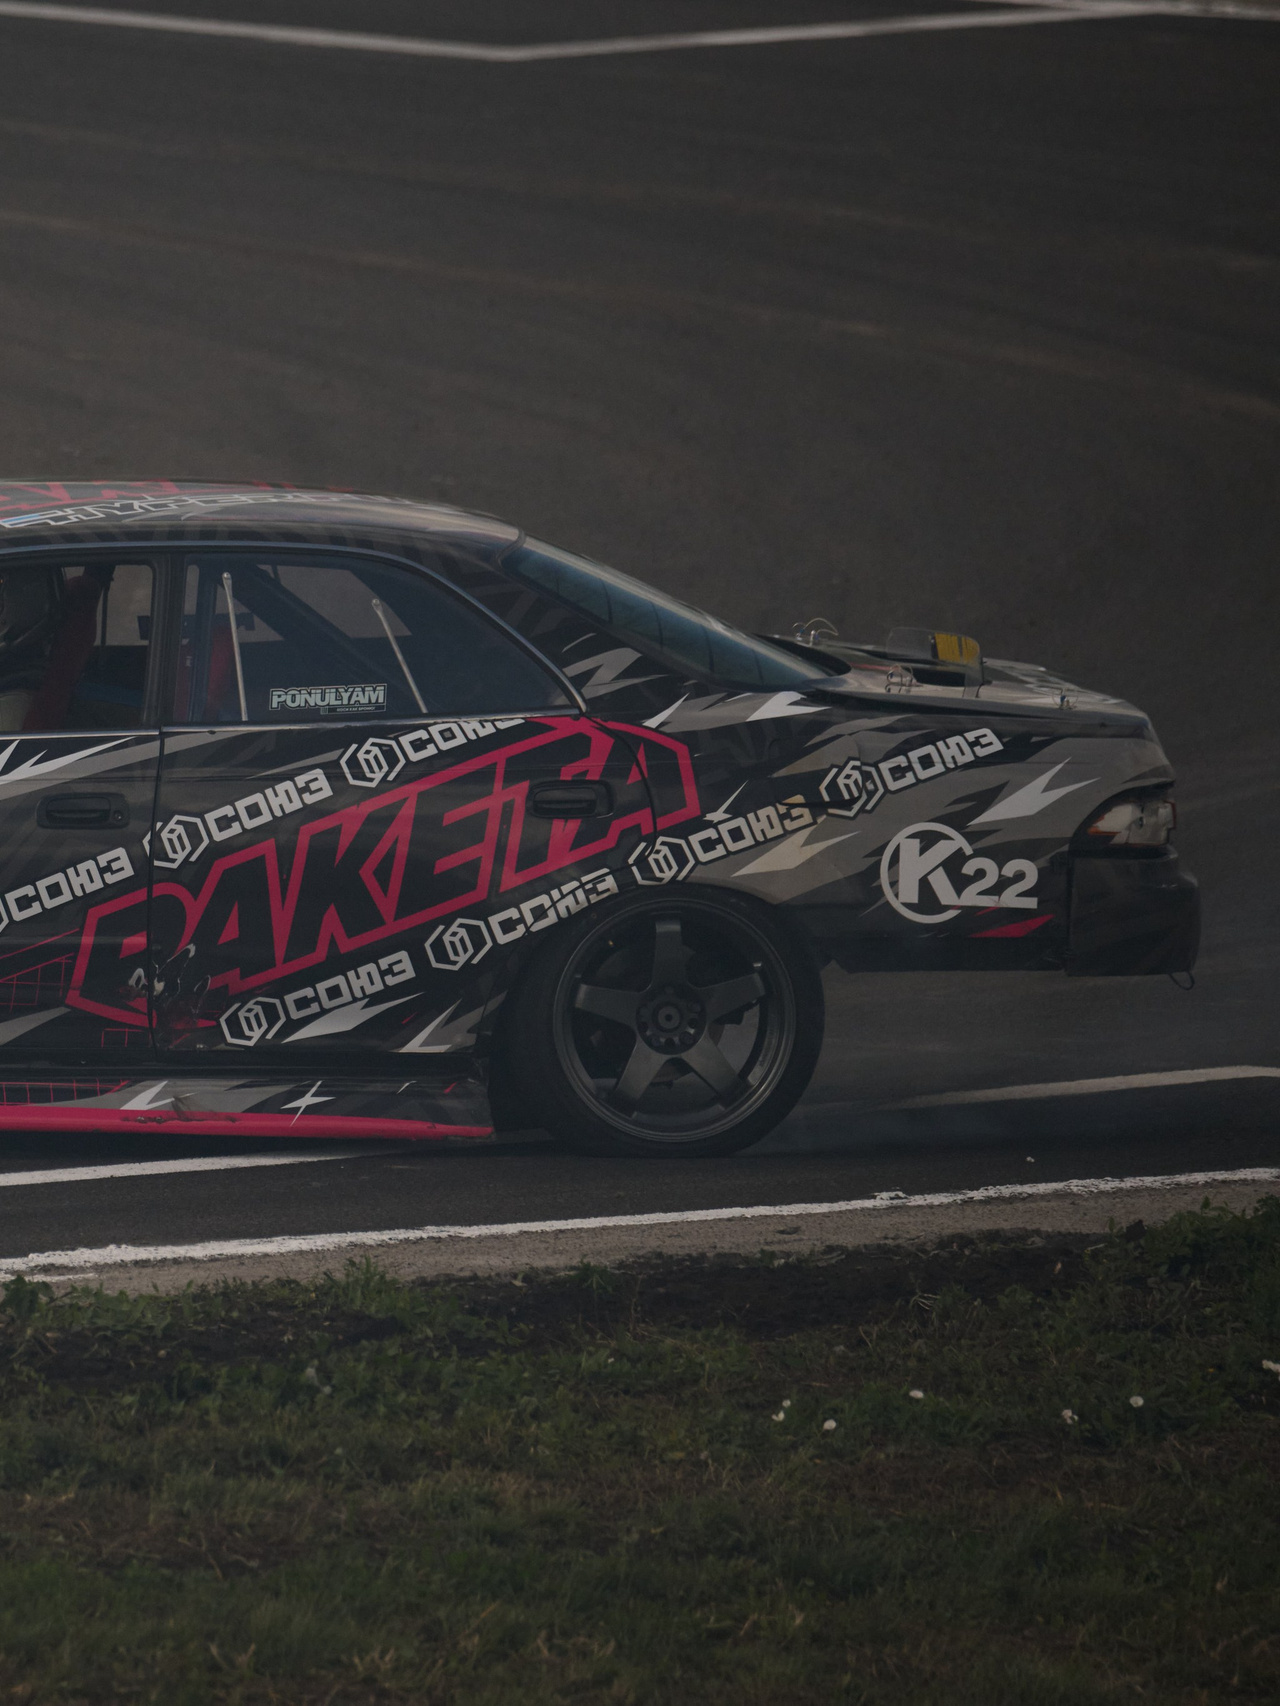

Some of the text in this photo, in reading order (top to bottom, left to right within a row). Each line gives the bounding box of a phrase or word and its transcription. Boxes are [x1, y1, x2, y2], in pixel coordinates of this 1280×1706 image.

[271, 685, 385, 709] PONULYAM
[877, 727, 1005, 792] СОЮЗ
[208, 768, 334, 841] СОЮЗ
[687, 794, 814, 863] СОЮЗ
[5, 846, 135, 921] СОЮЗ
[487, 867, 620, 945] СОЮЗ
[283, 950, 416, 1020] СОЮЗ
